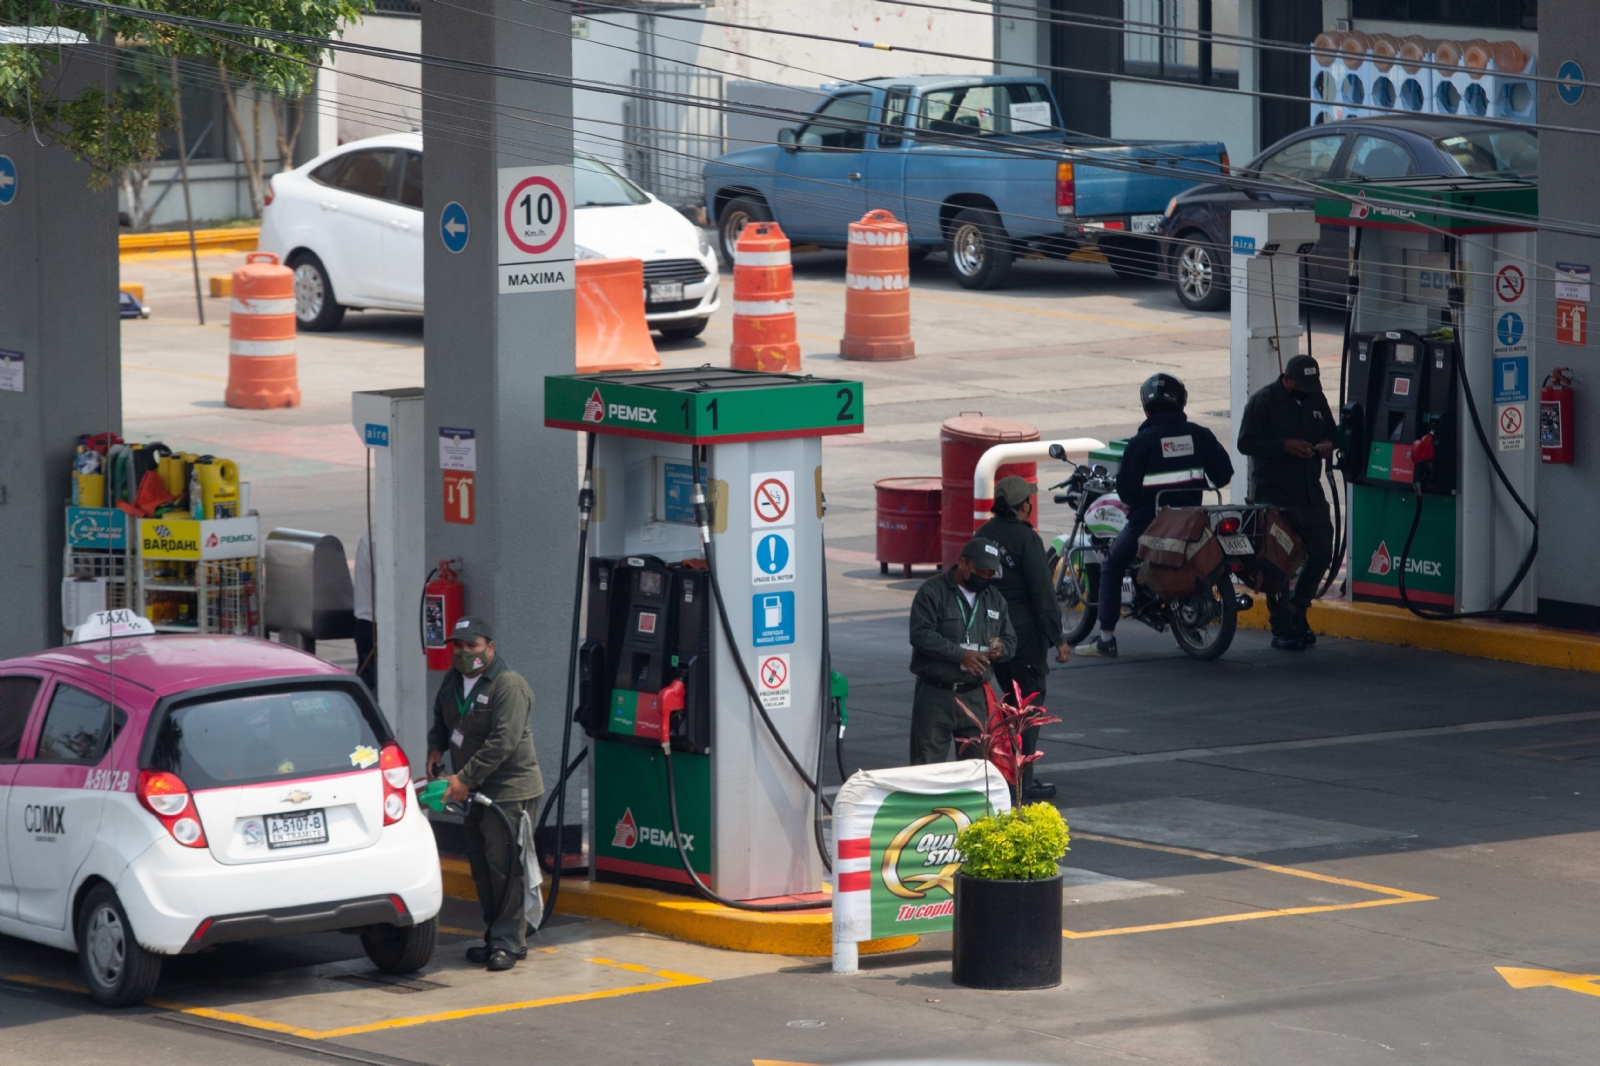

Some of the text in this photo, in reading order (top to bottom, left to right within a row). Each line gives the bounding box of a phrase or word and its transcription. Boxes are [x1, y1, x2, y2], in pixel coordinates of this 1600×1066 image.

[520, 192, 553, 226] 10
[1234, 239, 1254, 249] aire
[508, 271, 566, 286] MAXIMA
[836, 387, 854, 421] 2
[608, 403, 657, 424] PEMEX
[680, 398, 690, 430] 1
[705, 397, 718, 430] 1
[366, 427, 388, 440] aire
[143, 538, 198, 553] BARDAHL
[220, 534, 254, 544] PEMEX
[1392, 556, 1442, 577] PEMEX
[96, 610, 129, 625] TAXI
[761, 629, 784, 637] VERIFIQUE
[759, 689, 790, 697] PROHIBIDO
[83, 768, 130, 792] A-5107-B
[24, 804, 65, 834] CDMX
[271, 816, 322, 834] A-5107-B
[272, 829, 323, 842] EN TRAMITE
[915, 832, 958, 853] QUA
[895, 904, 916, 921] Tu
